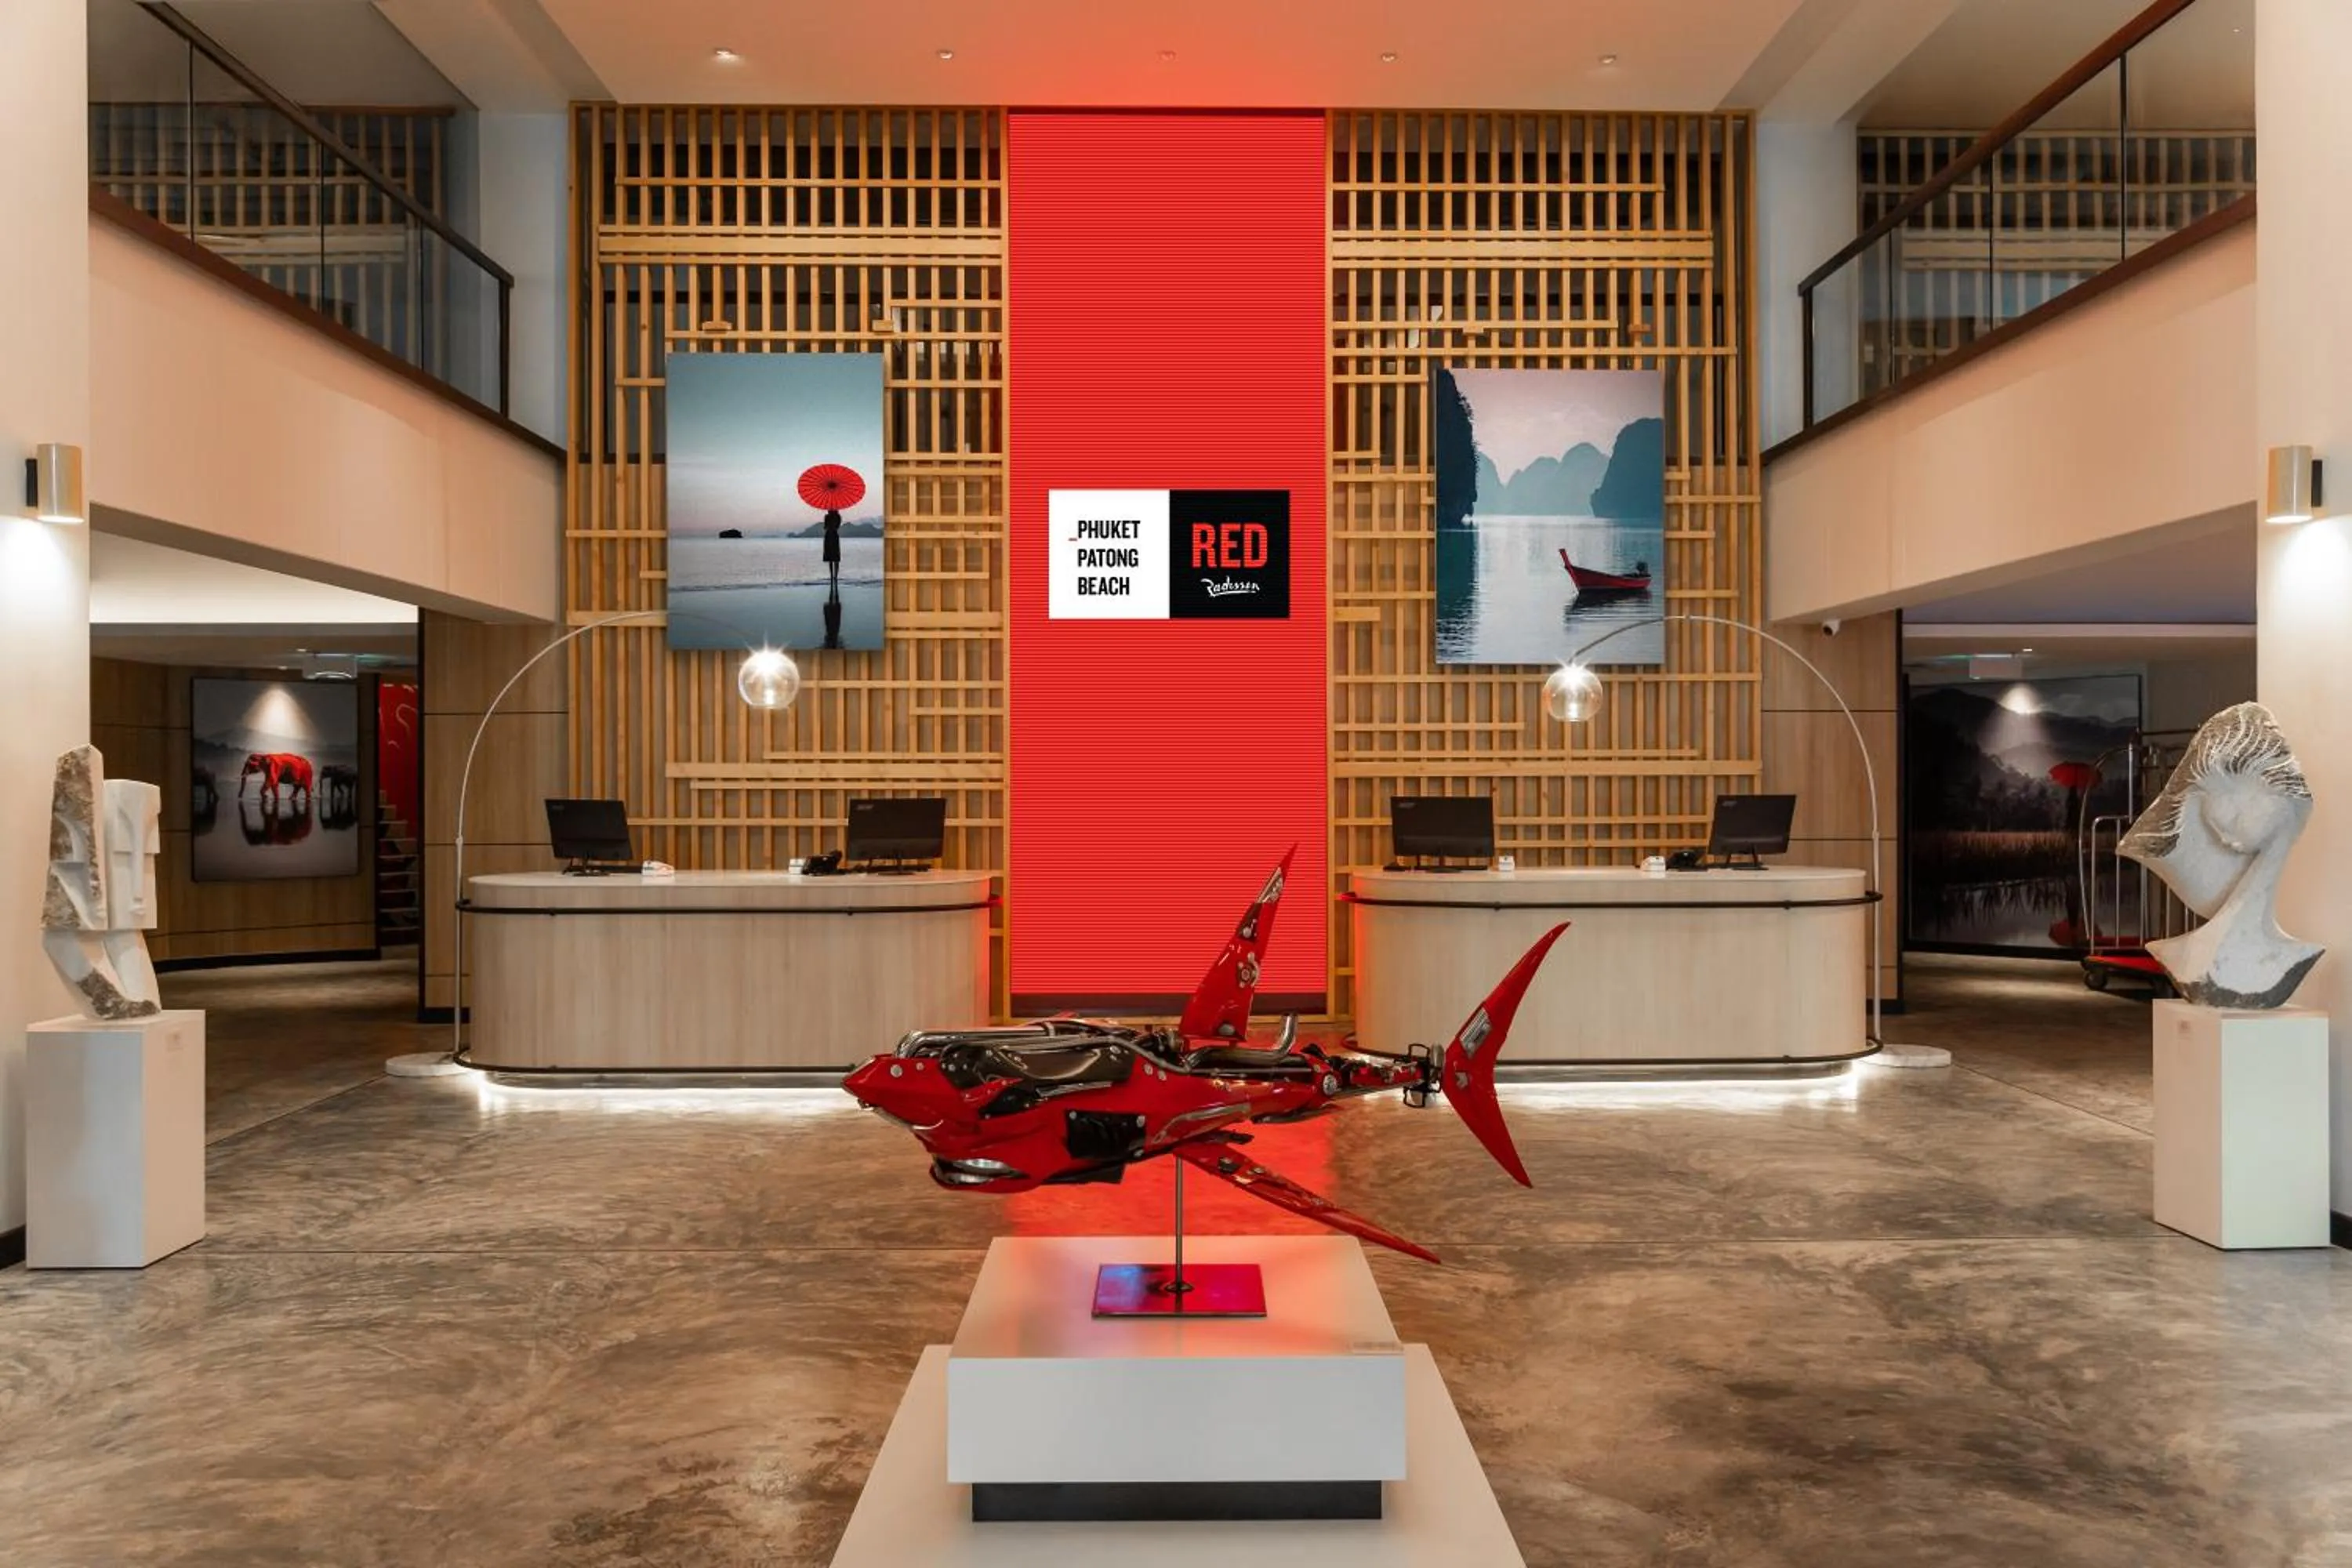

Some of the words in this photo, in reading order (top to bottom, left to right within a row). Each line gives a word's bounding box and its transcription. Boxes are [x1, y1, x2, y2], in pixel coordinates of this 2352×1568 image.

[1192, 523, 1268, 568] RED
[1077, 549, 1138, 567] PATONG
[1077, 577, 1130, 595] BEACH
